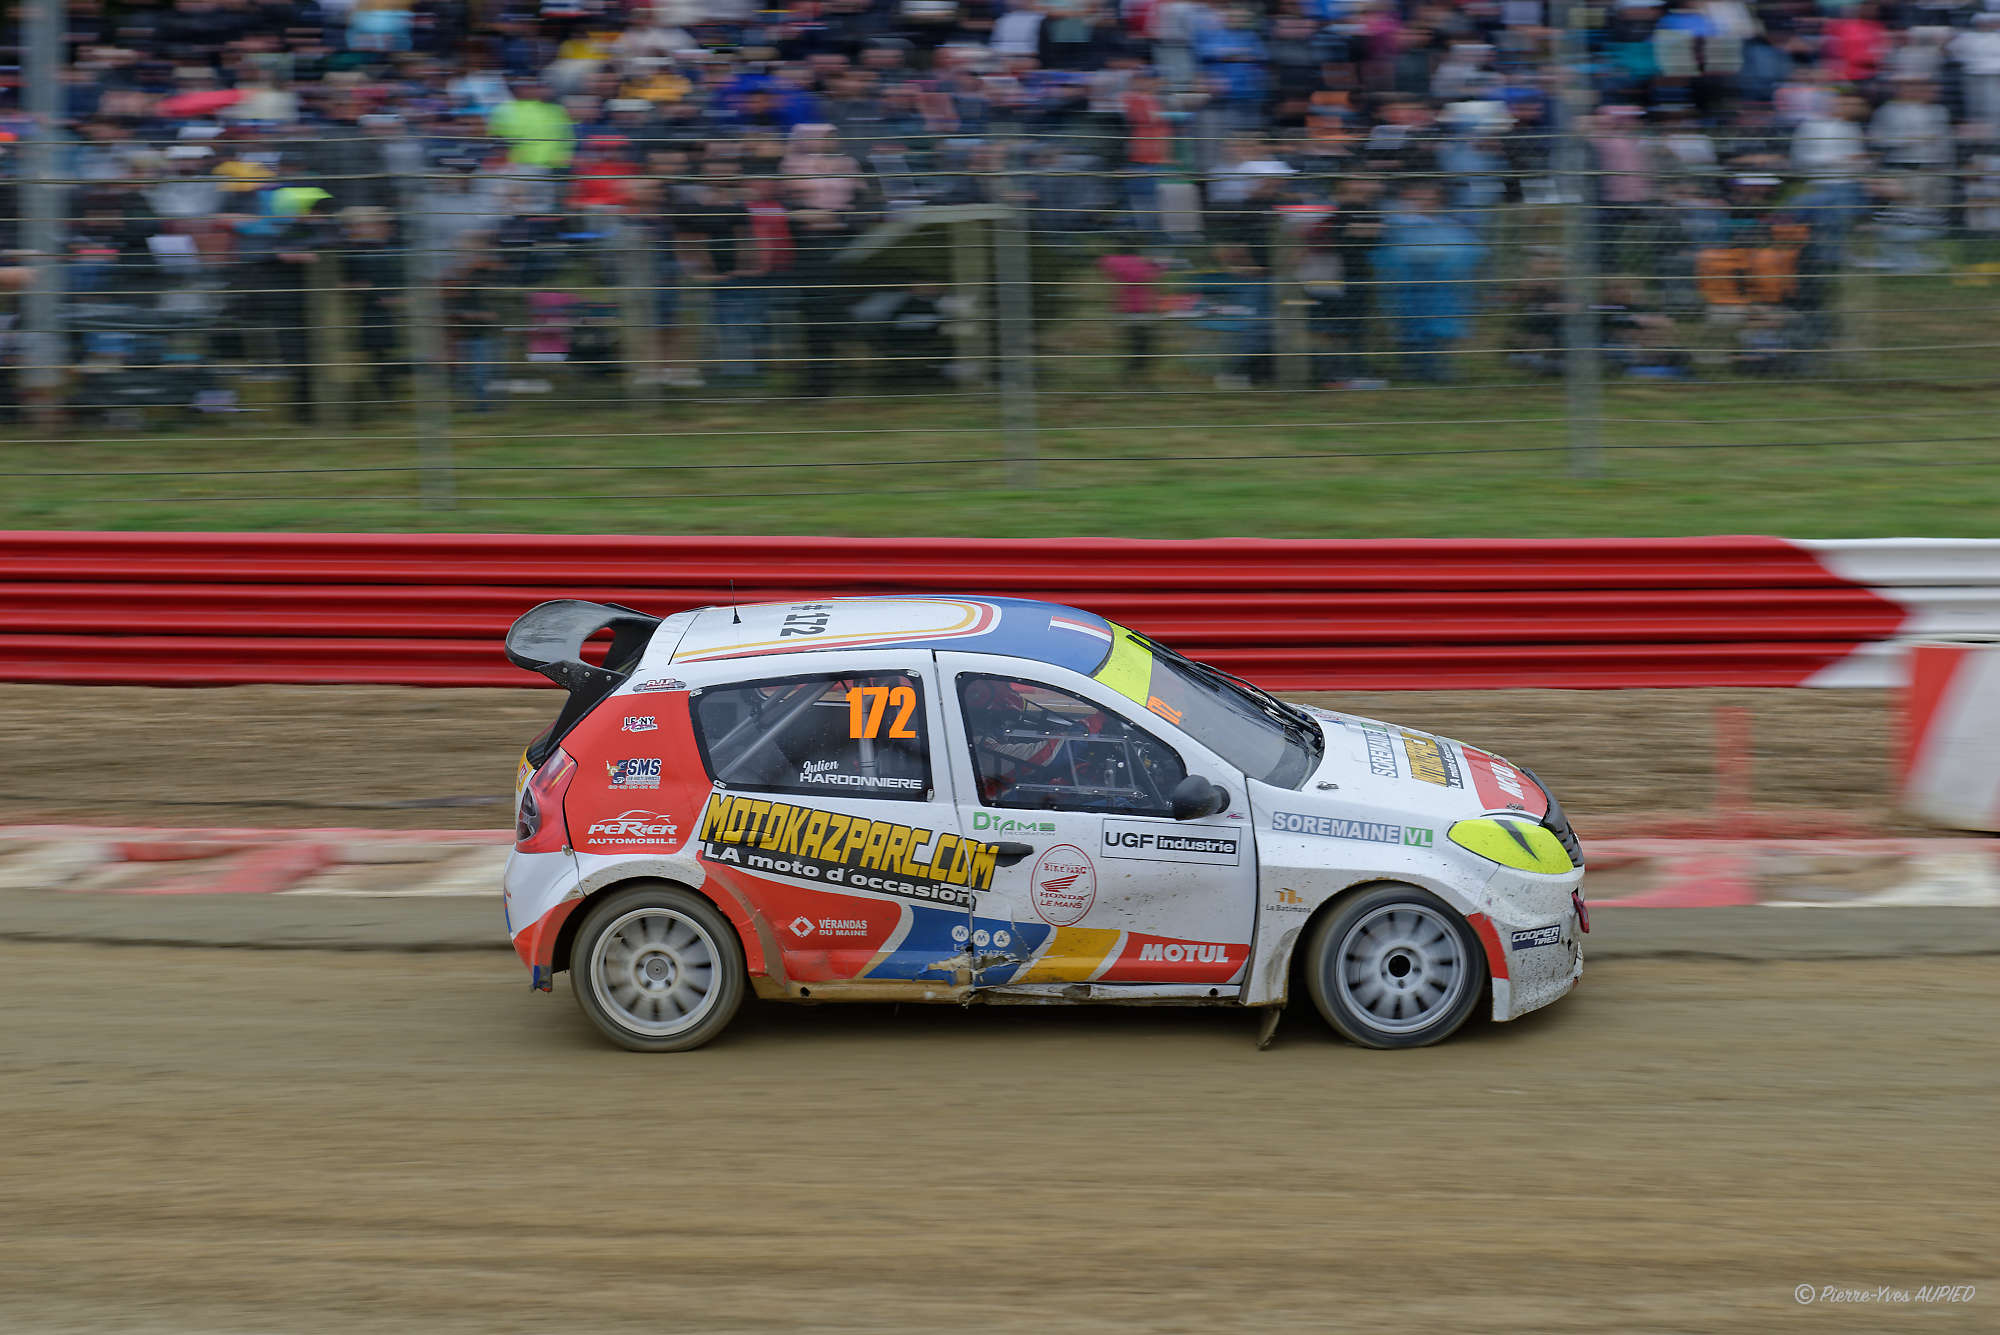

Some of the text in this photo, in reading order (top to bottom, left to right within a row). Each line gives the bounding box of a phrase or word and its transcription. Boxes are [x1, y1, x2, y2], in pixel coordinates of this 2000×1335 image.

[845, 686, 917, 739] 172
[627, 759, 661, 776] SMS
[803, 760, 839, 775] Julien
[800, 772, 923, 789] HARDONNIERE
[1272, 812, 1433, 846] SOREMAINE VL
[699, 792, 999, 891] MOTOKAZPARC.COM
[1105, 832, 1235, 853] UGF industrie
[705, 843, 740, 863] LA
[747, 854, 822, 878] moto
[1040, 891, 1085, 900] HONDA
[1040, 899, 1083, 909] LE MANS
[819, 917, 868, 929] VÉRANDAS
[1512, 926, 1560, 943] COOPER
[1534, 935, 1558, 945] TIRES
[1139, 944, 1230, 963] MOTUL
